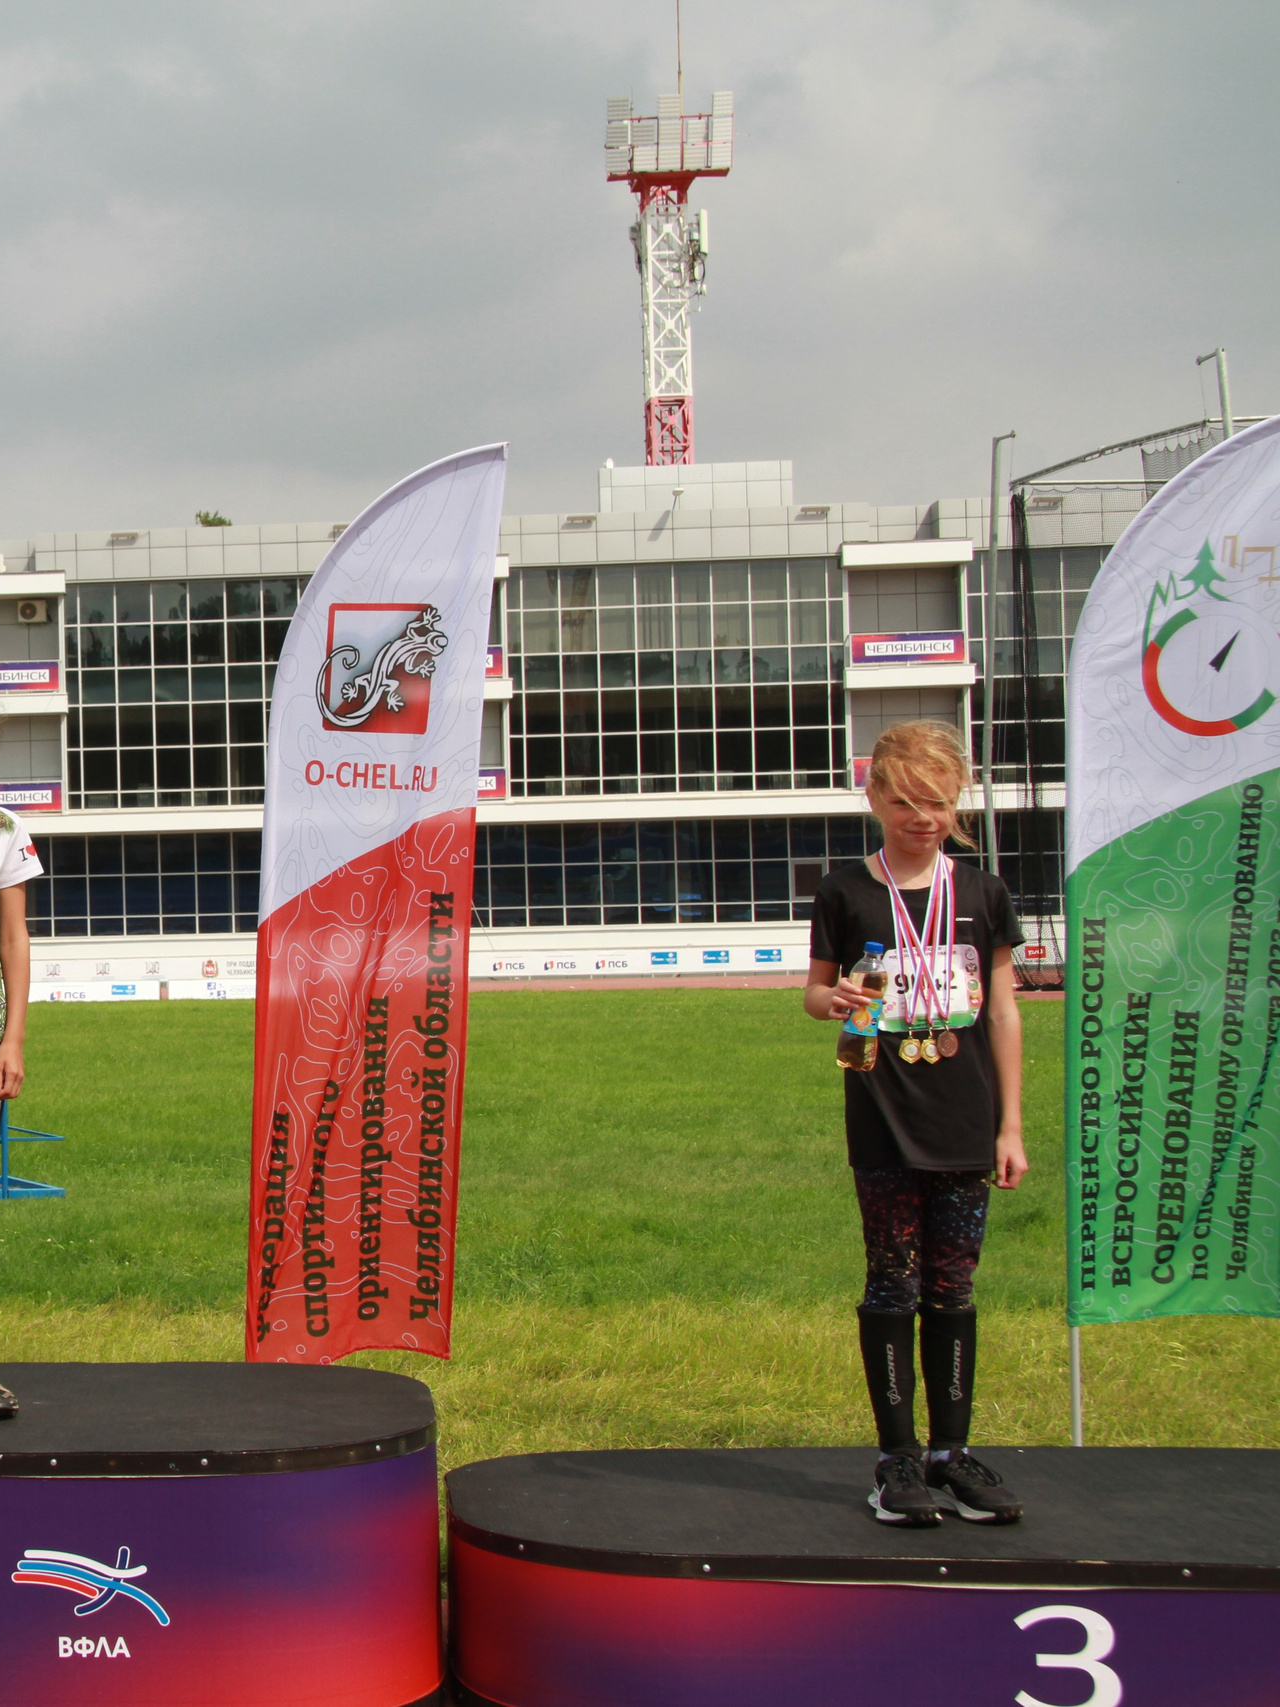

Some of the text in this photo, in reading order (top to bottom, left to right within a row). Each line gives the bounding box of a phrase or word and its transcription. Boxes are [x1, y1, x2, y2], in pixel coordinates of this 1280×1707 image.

[867, 641, 952, 654] ЧЕЛЯБИНСК
[305, 760, 438, 792] O-CHEL.RU
[64, 991, 86, 999] ПСБ
[505, 962, 525, 970] ПСБ
[556, 961, 576, 969] ПСБ
[608, 960, 628, 968] ПСБ
[1191, 1243, 1208, 1281] ПО
[1221, 783, 1264, 1046] ОРИЕНТИРОВАНИЮ
[406, 891, 455, 1321] Челябинской области
[1080, 917, 1106, 1291] ПЕРВЕНСТВО РОССИИ
[1111, 992, 1152, 1288] ВСЕРОССИЙСКИЕ
[357, 996, 392, 1321] ориентирования
[1151, 1009, 1200, 1284] СОРЕВНОВАНИЯ
[303, 1080, 340, 1338] спортивного
[1225, 1144, 1256, 1281] Челябинск
[886, 1343, 897, 1388] NORD
[953, 1339, 961, 1384] NORD
[58, 1636, 131, 1658] ВФЛА
[1013, 1604, 1123, 1707] 3
